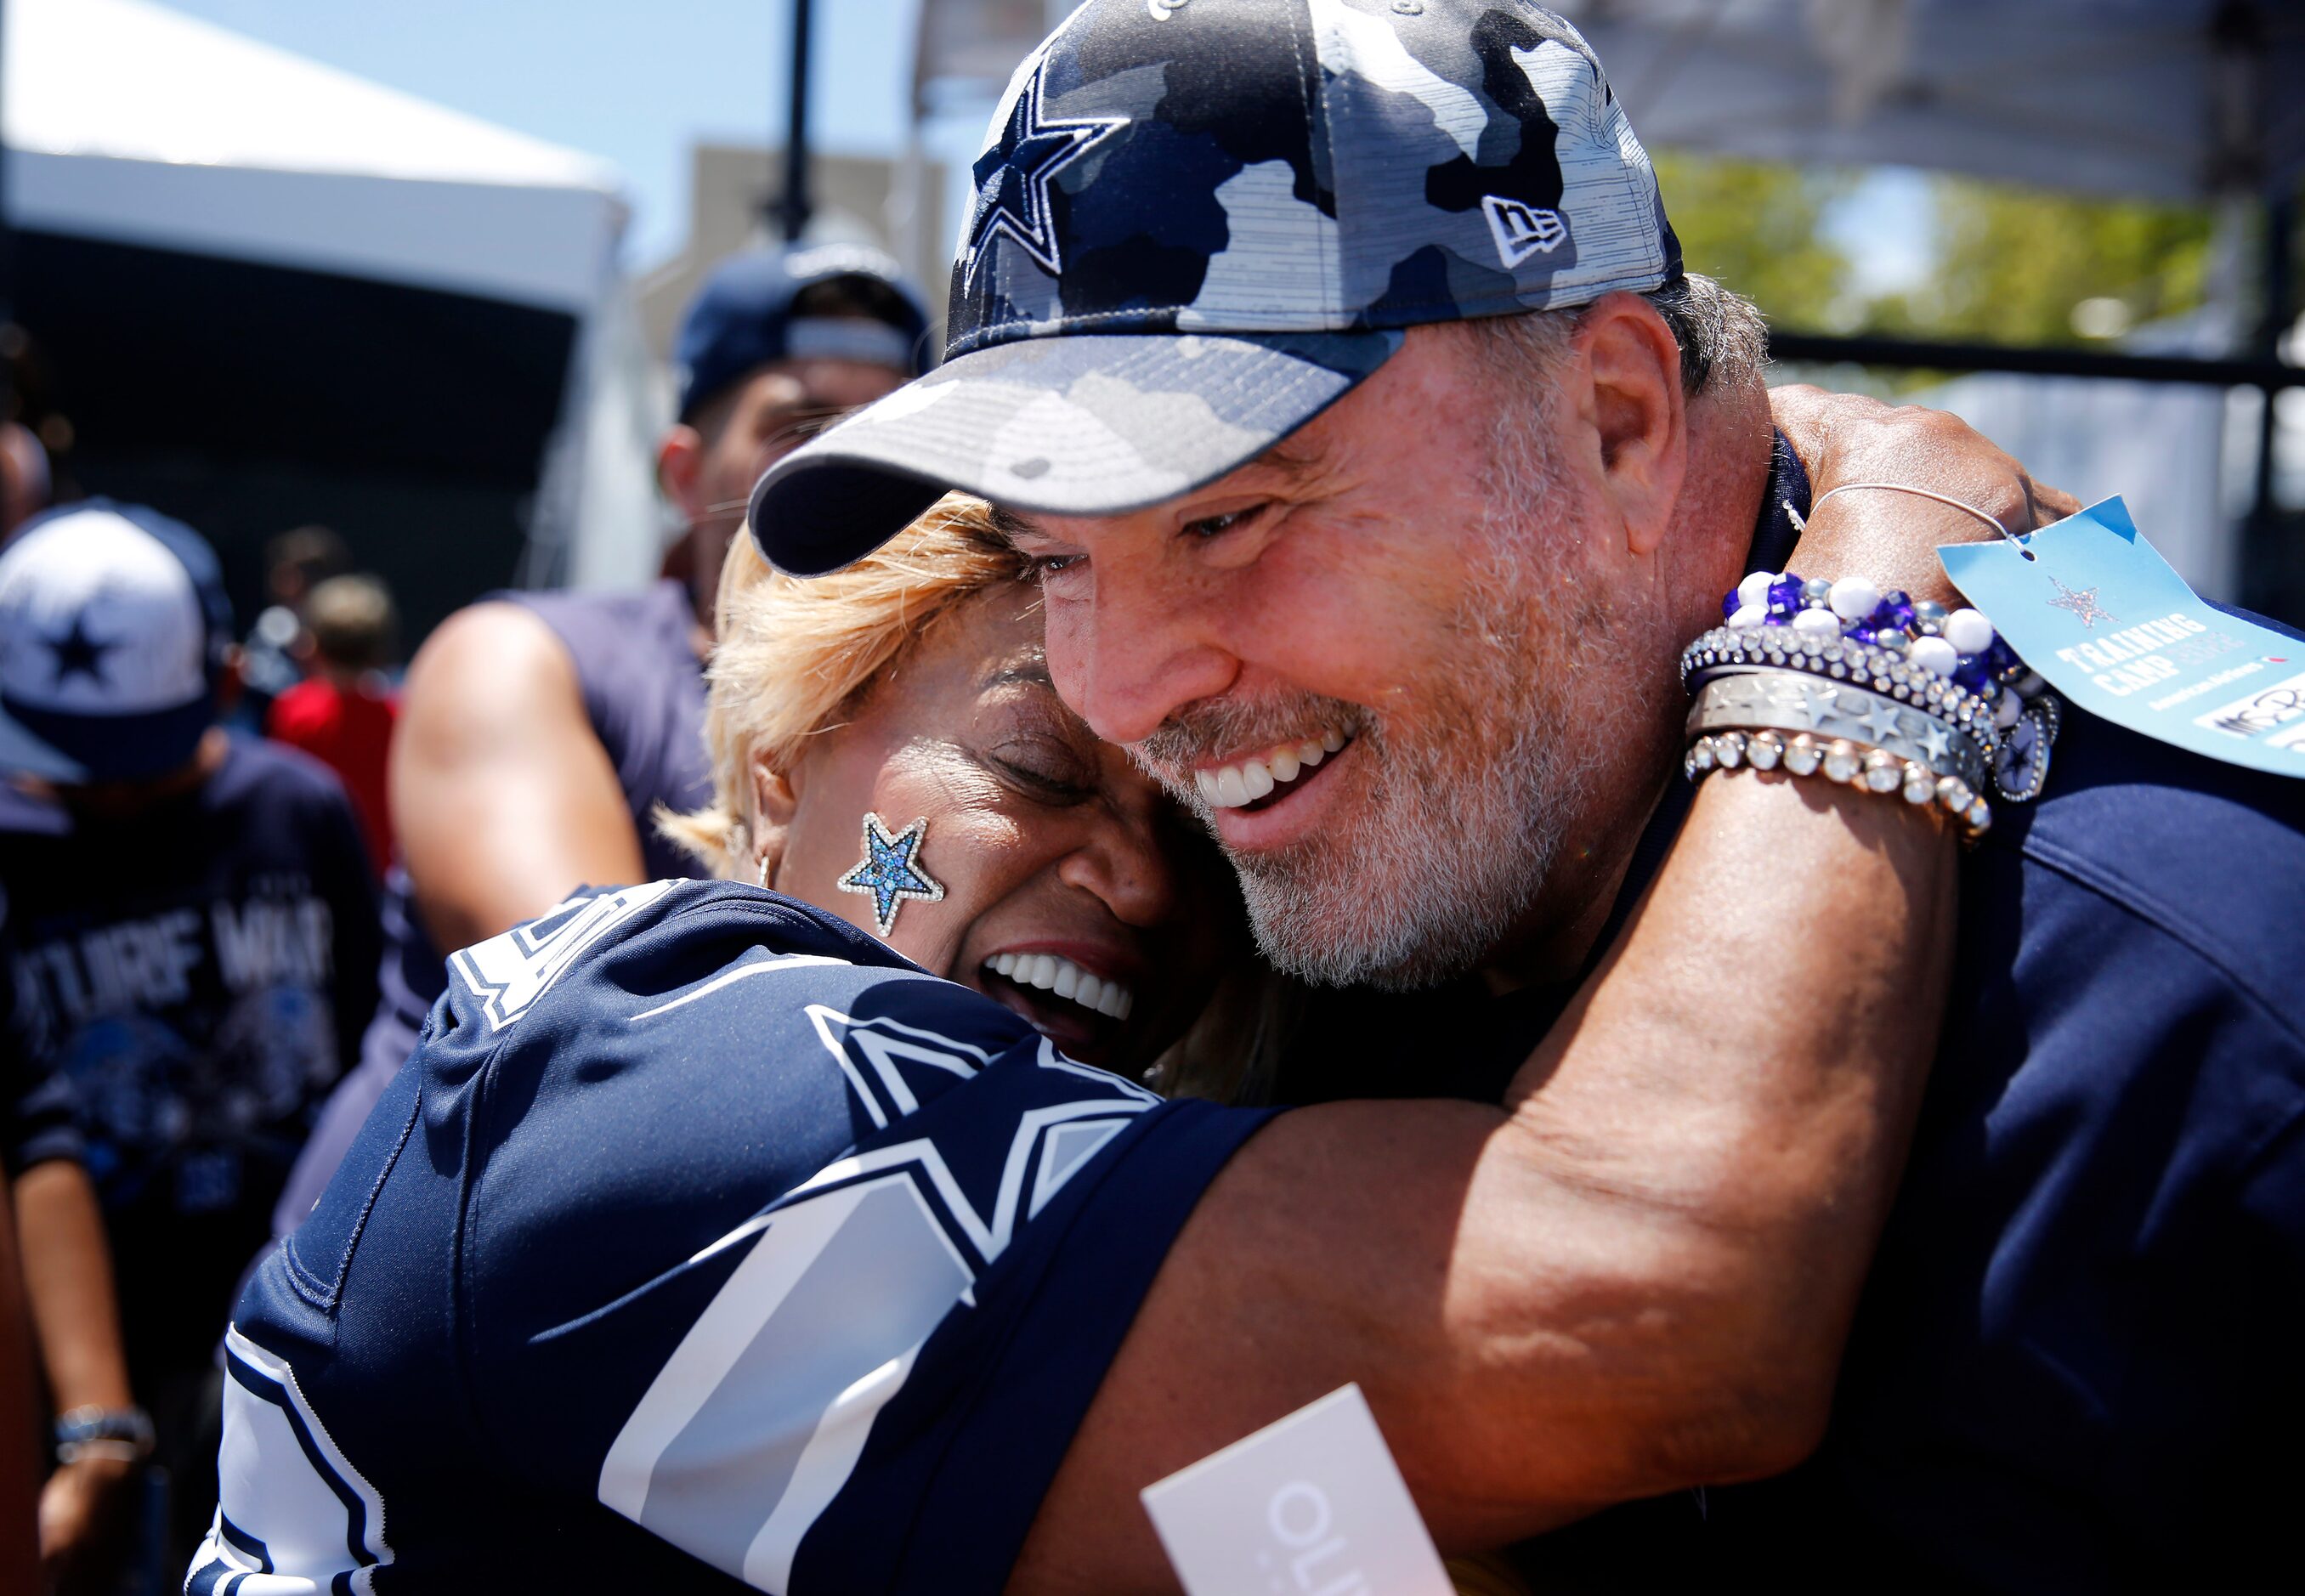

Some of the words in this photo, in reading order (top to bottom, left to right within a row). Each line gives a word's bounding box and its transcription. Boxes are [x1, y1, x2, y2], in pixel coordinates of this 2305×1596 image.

[2055, 613, 2207, 674] TRAINING
[2093, 654, 2181, 697] CAMP
[1268, 1482, 1372, 1596] OLI
